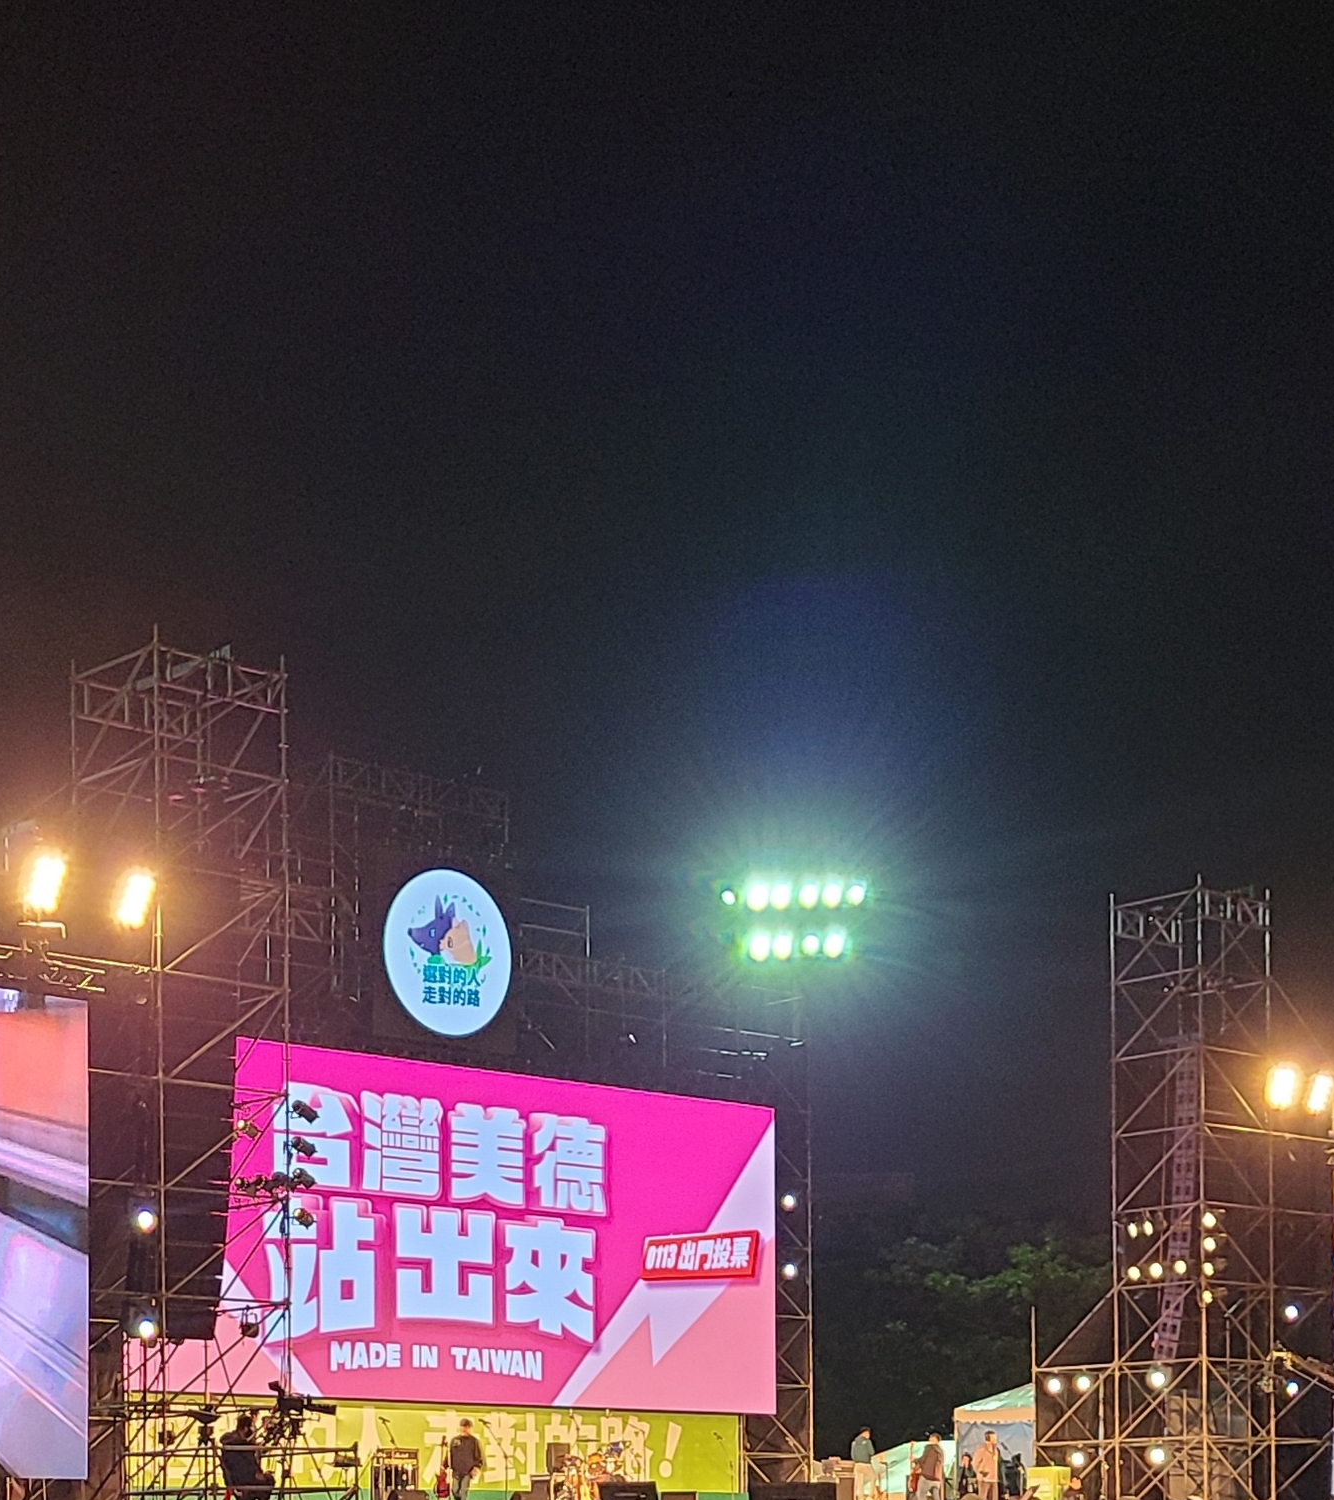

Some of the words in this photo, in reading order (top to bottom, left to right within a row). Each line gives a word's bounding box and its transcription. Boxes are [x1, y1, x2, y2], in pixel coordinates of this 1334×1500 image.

[422, 986, 480, 1007] 走對的路
[272, 1081, 606, 1217] 台灣美德
[263, 1196, 595, 1344] 站出來
[645, 1244, 678, 1270] 0113
[677, 1237, 752, 1270] 出門投票
[330, 1341, 401, 1371] MADE
[411, 1344, 439, 1368] IN
[451, 1347, 543, 1381] TAIWAN
